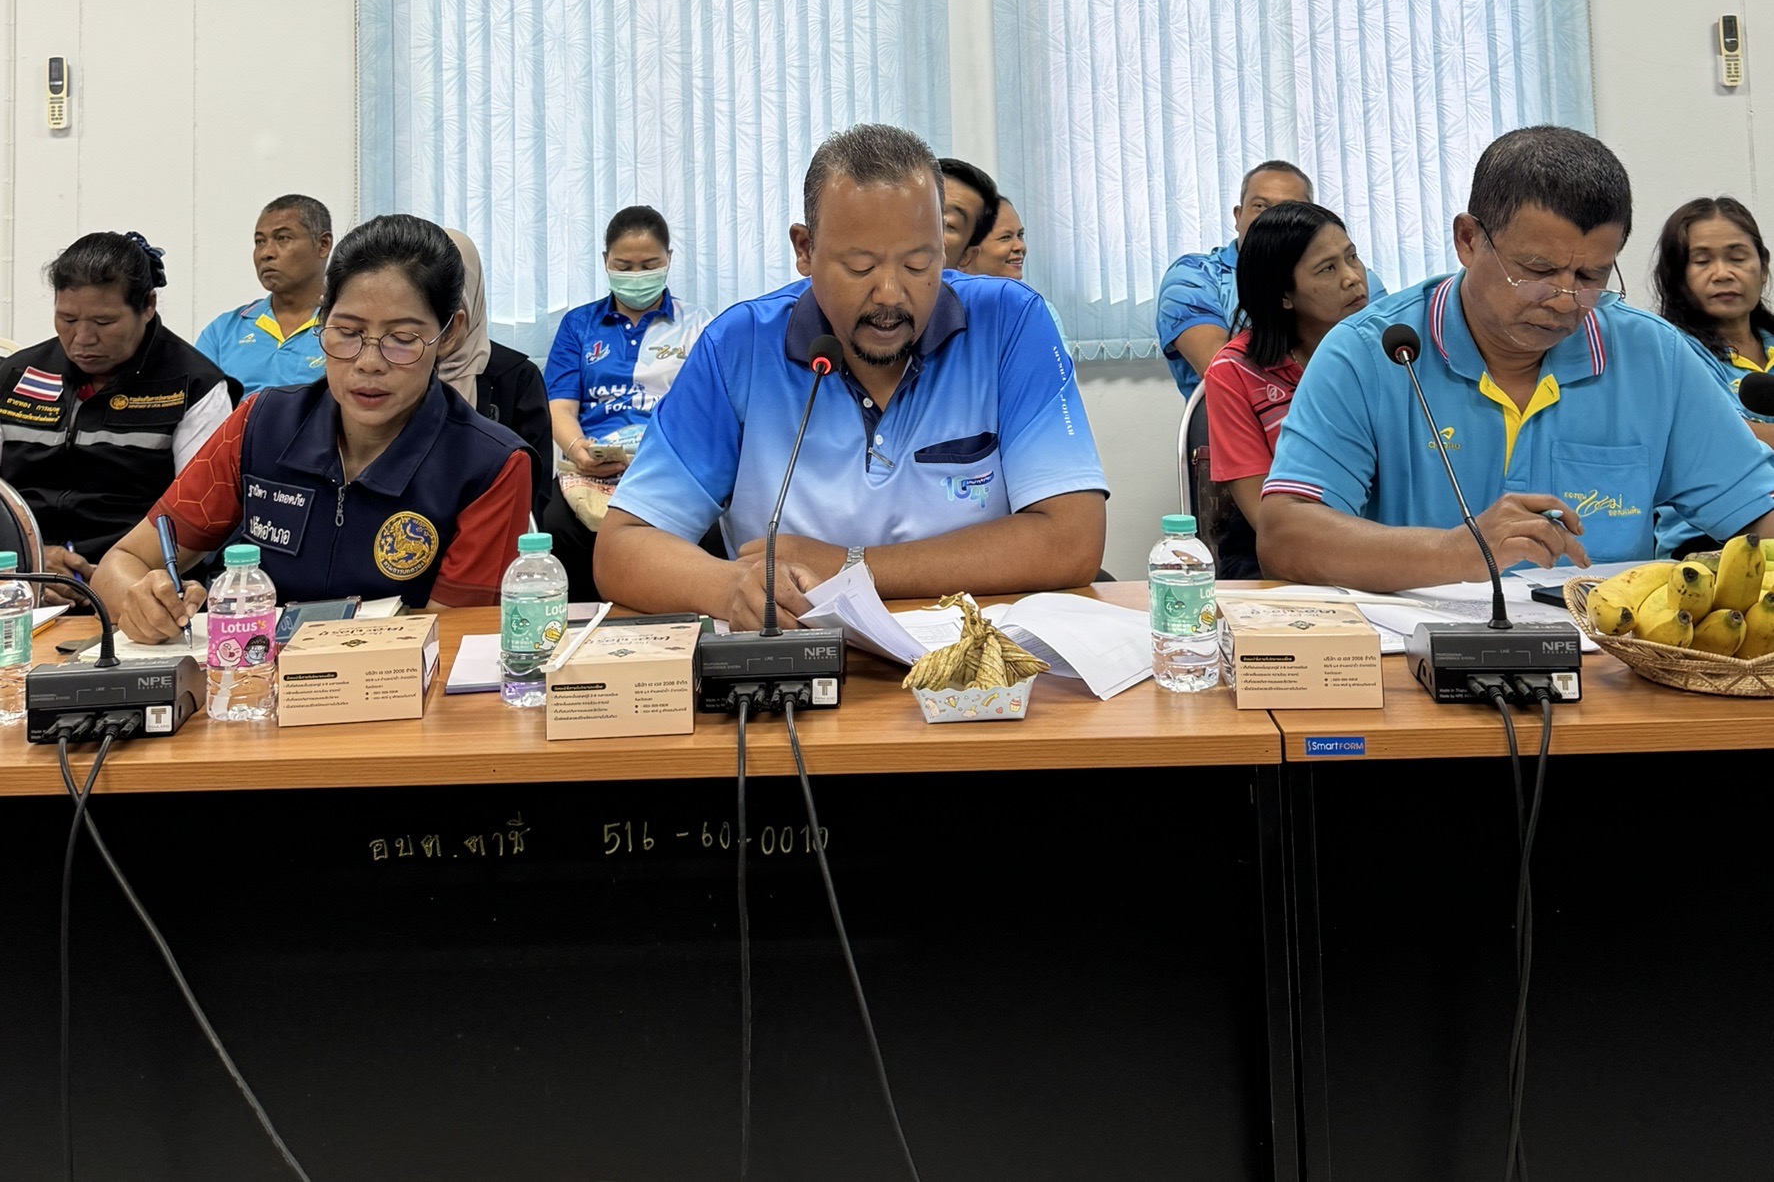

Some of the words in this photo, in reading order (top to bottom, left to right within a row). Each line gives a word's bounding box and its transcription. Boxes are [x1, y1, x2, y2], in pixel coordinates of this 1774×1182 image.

[221, 620, 267, 633] Lotus's
[1542, 641, 1577, 651] NPE
[804, 647, 837, 657] NPE
[138, 675, 173, 686] NPE
